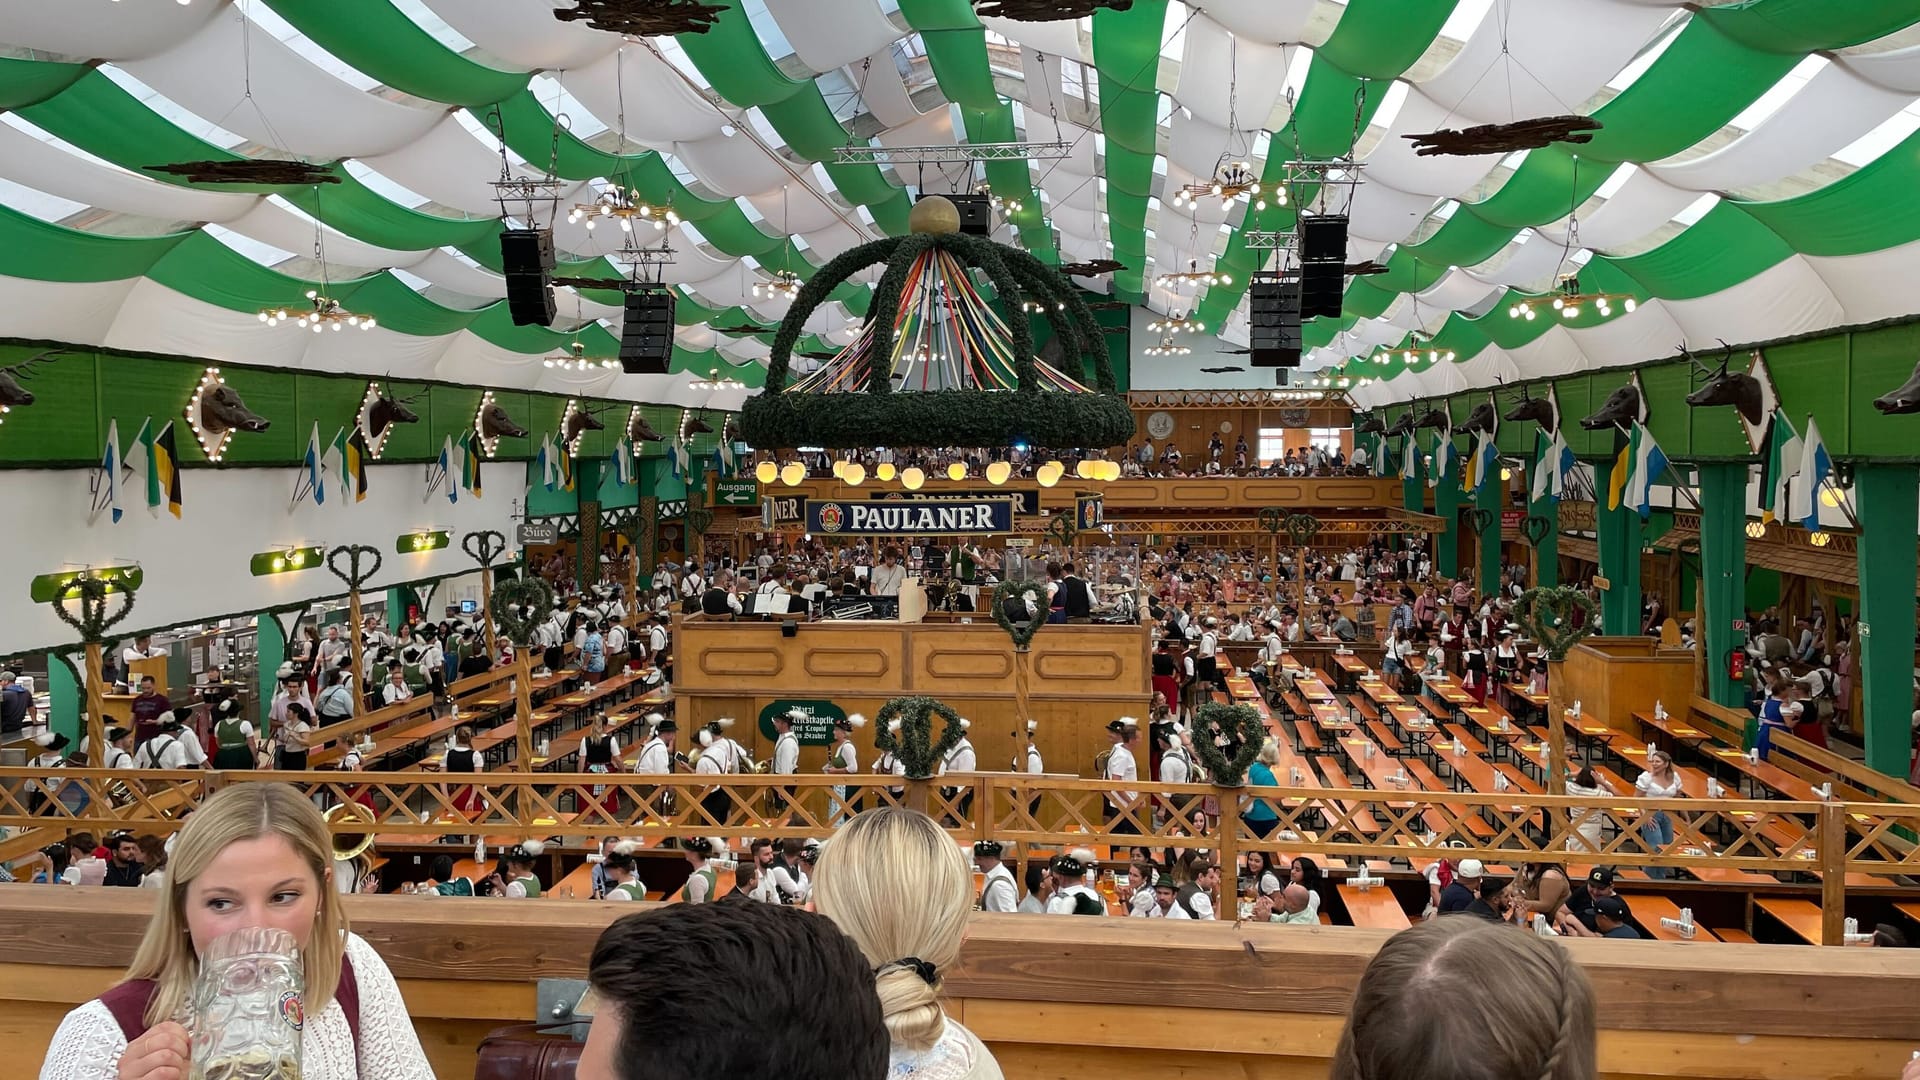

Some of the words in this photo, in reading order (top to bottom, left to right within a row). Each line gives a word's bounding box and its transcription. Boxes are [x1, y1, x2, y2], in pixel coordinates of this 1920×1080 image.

[717, 482, 755, 492] Ausgang
[774, 498, 799, 520] NER
[850, 503, 995, 531] PAULANER
[522, 526, 552, 537] Büro
